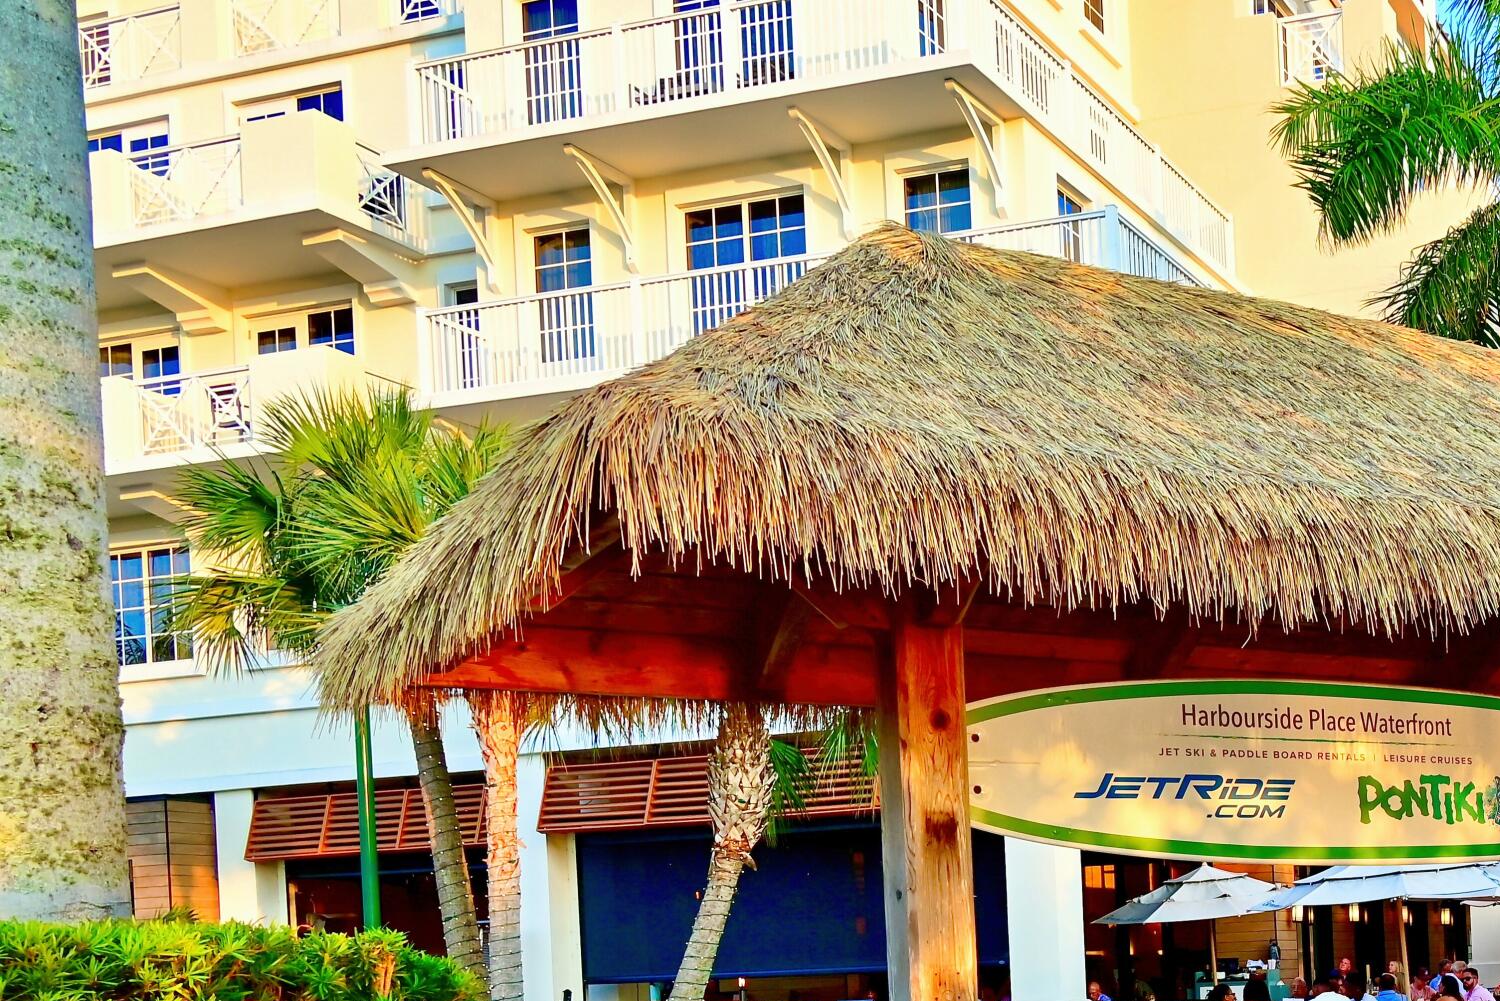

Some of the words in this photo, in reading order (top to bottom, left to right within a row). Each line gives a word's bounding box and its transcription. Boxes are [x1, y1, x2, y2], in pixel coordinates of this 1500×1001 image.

[1181, 703, 1304, 730] Harbourside
[1308, 708, 1356, 732] Place
[1360, 711, 1452, 736] Waterfront
[1158, 747, 1180, 757] JET
[1185, 747, 1205, 757] SKI
[1209, 749, 1217, 758] &
[1222, 749, 1268, 759] PADDLE
[1273, 750, 1313, 760] BOARD
[1317, 752, 1366, 762] RENTALS
[1383, 754, 1426, 764] LEISURE
[1430, 755, 1473, 765] CRUISES
[1206, 804, 1286, 819] .COM
